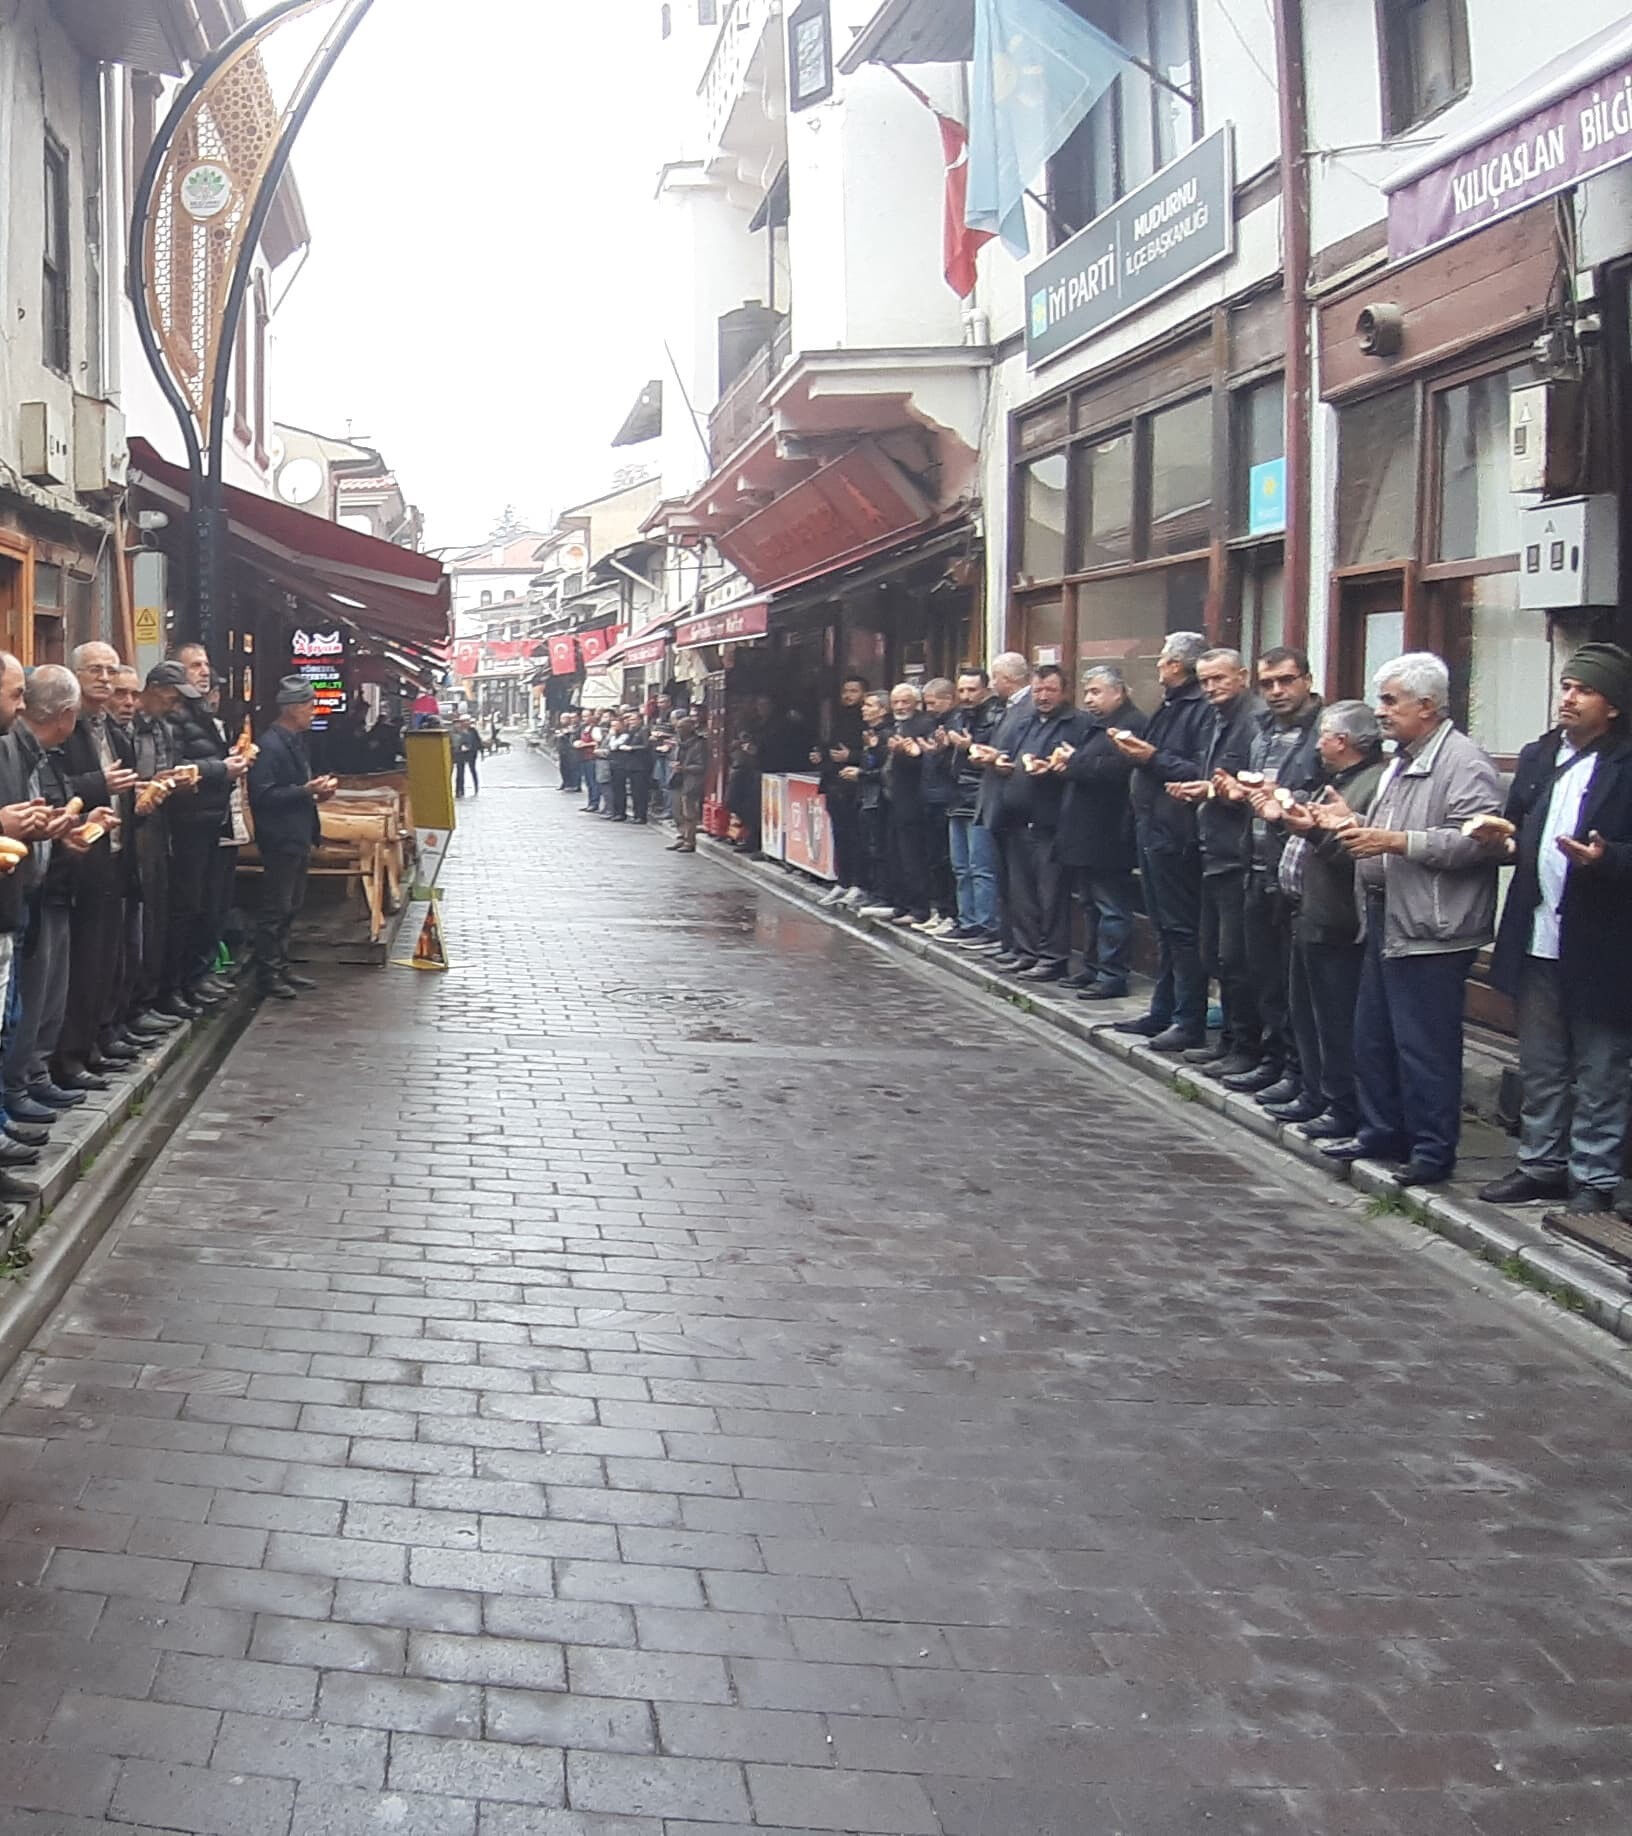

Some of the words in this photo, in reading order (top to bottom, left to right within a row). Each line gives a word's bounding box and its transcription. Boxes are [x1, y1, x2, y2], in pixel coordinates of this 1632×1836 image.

[1134, 177, 1197, 241] MUDURNU
[1452, 124, 1568, 215] KILIÇASLAN
[1048, 276, 1067, 325] İYİ
[1067, 243, 1115, 313] PARTİ
